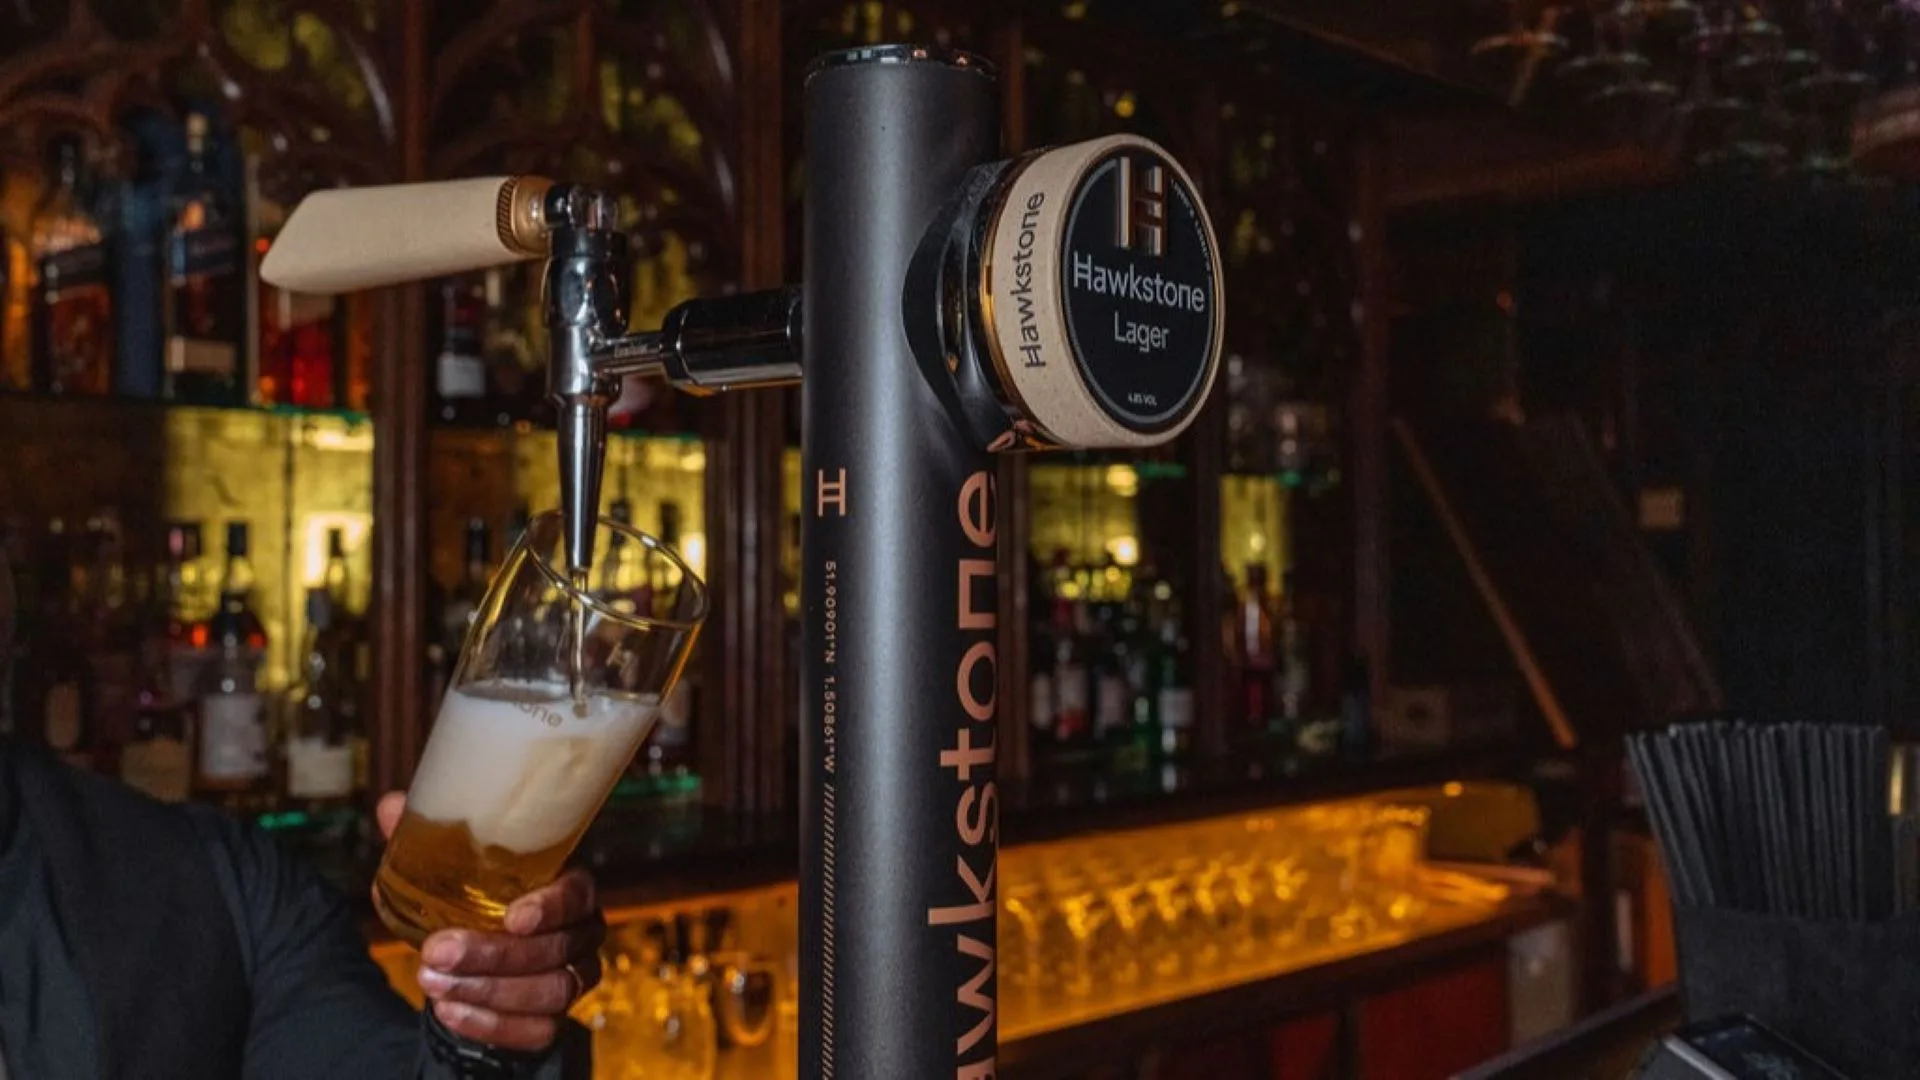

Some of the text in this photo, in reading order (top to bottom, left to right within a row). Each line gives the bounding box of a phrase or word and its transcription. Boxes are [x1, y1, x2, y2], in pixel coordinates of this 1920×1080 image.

[1010, 191, 1046, 369] Hawkstone
[1072, 251, 1206, 313] Hawkstone
[1114, 311, 1170, 352] Lager
